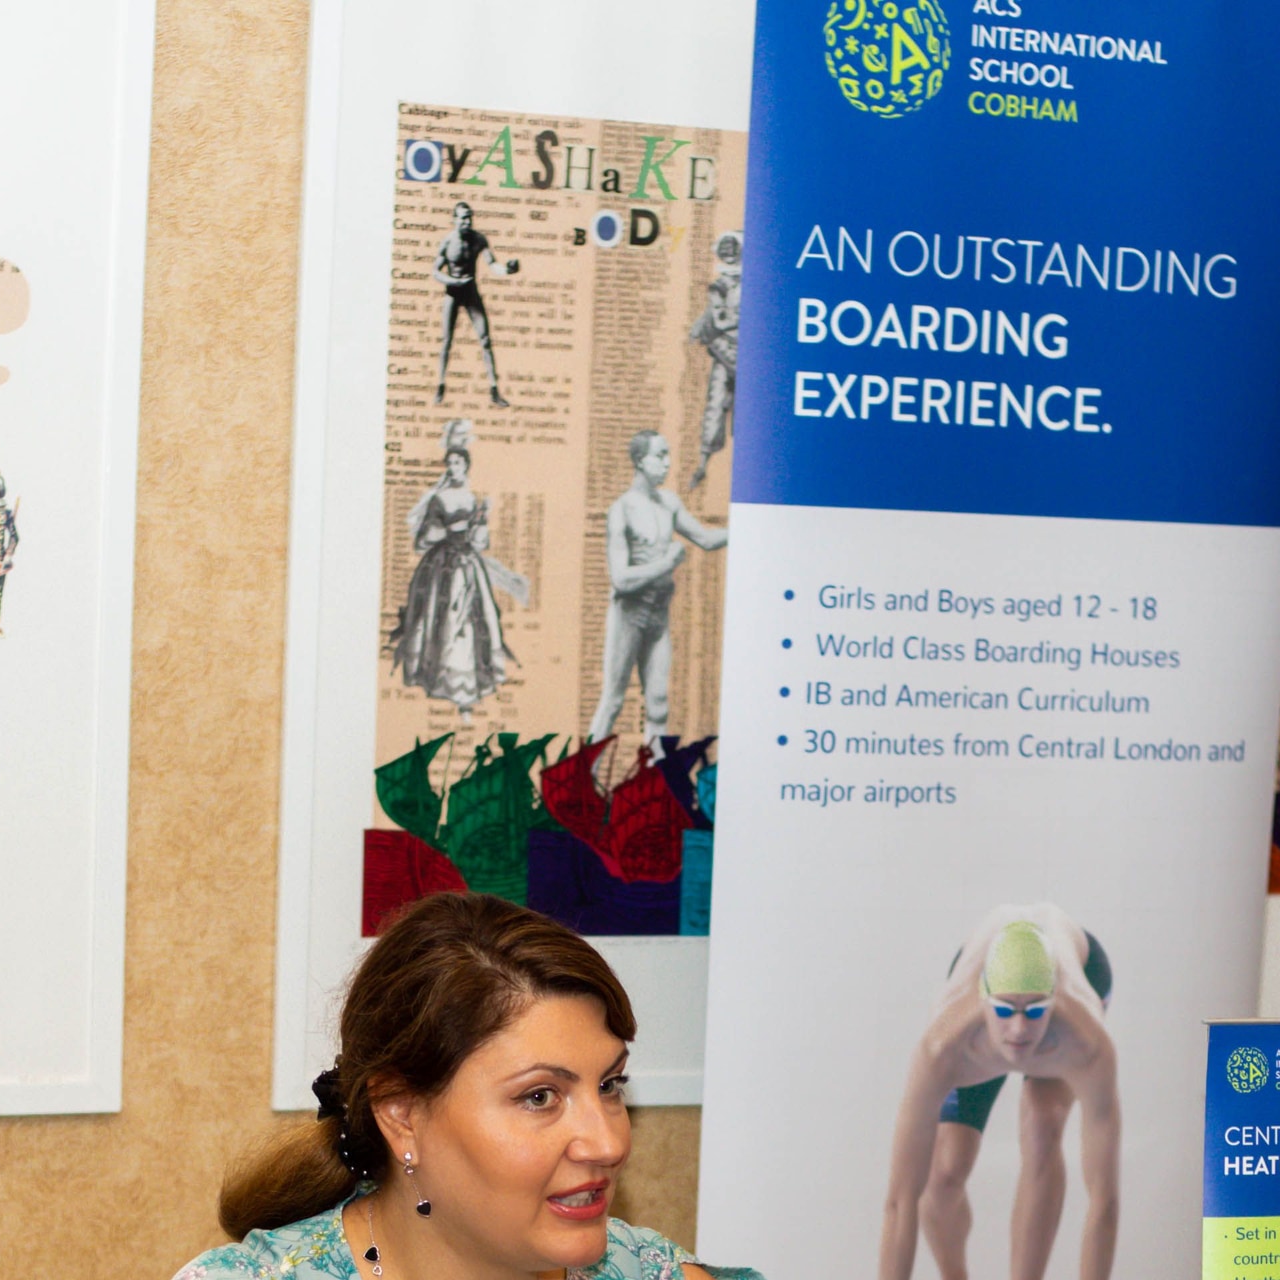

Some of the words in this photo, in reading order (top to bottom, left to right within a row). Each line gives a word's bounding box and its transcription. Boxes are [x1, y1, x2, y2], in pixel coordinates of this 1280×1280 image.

[973, 0, 1021, 18] ACS
[971, 24, 1167, 65] INTERNATIONAL
[969, 57, 1074, 89] SCHOOL
[968, 91, 1078, 122] COBHAM
[796, 224, 873, 273] AN
[888, 231, 1237, 299] OUTSTANDING
[797, 298, 1068, 359] BOARDING
[794, 371, 1112, 433] EXPERIENCE.
[819, 584, 875, 610] Girls
[884, 589, 929, 612] and
[938, 589, 995, 619] Boys
[1003, 594, 1062, 622] aged
[1074, 594, 1101, 619] 12
[1130, 597, 1157, 621] 18
[816, 633, 894, 659] World
[903, 636, 965, 661] Class
[974, 638, 1081, 671] Boarding
[1091, 643, 1180, 669] Houses
[806, 681, 832, 705] IB
[841, 684, 887, 707] and
[895, 684, 1008, 710] American
[1017, 686, 1150, 713] Curriculum
[805, 729, 836, 754] 30
[845, 731, 944, 756] minutes
[953, 732, 1009, 757] from
[1018, 734, 1105, 759] Central
[1114, 737, 1201, 762] London
[1207, 739, 1246, 763] and
[781, 778, 856, 807] major
[864, 779, 956, 808] airports
[1236, 1227, 1260, 1240] Set
[1265, 1227, 1277, 1240] in
